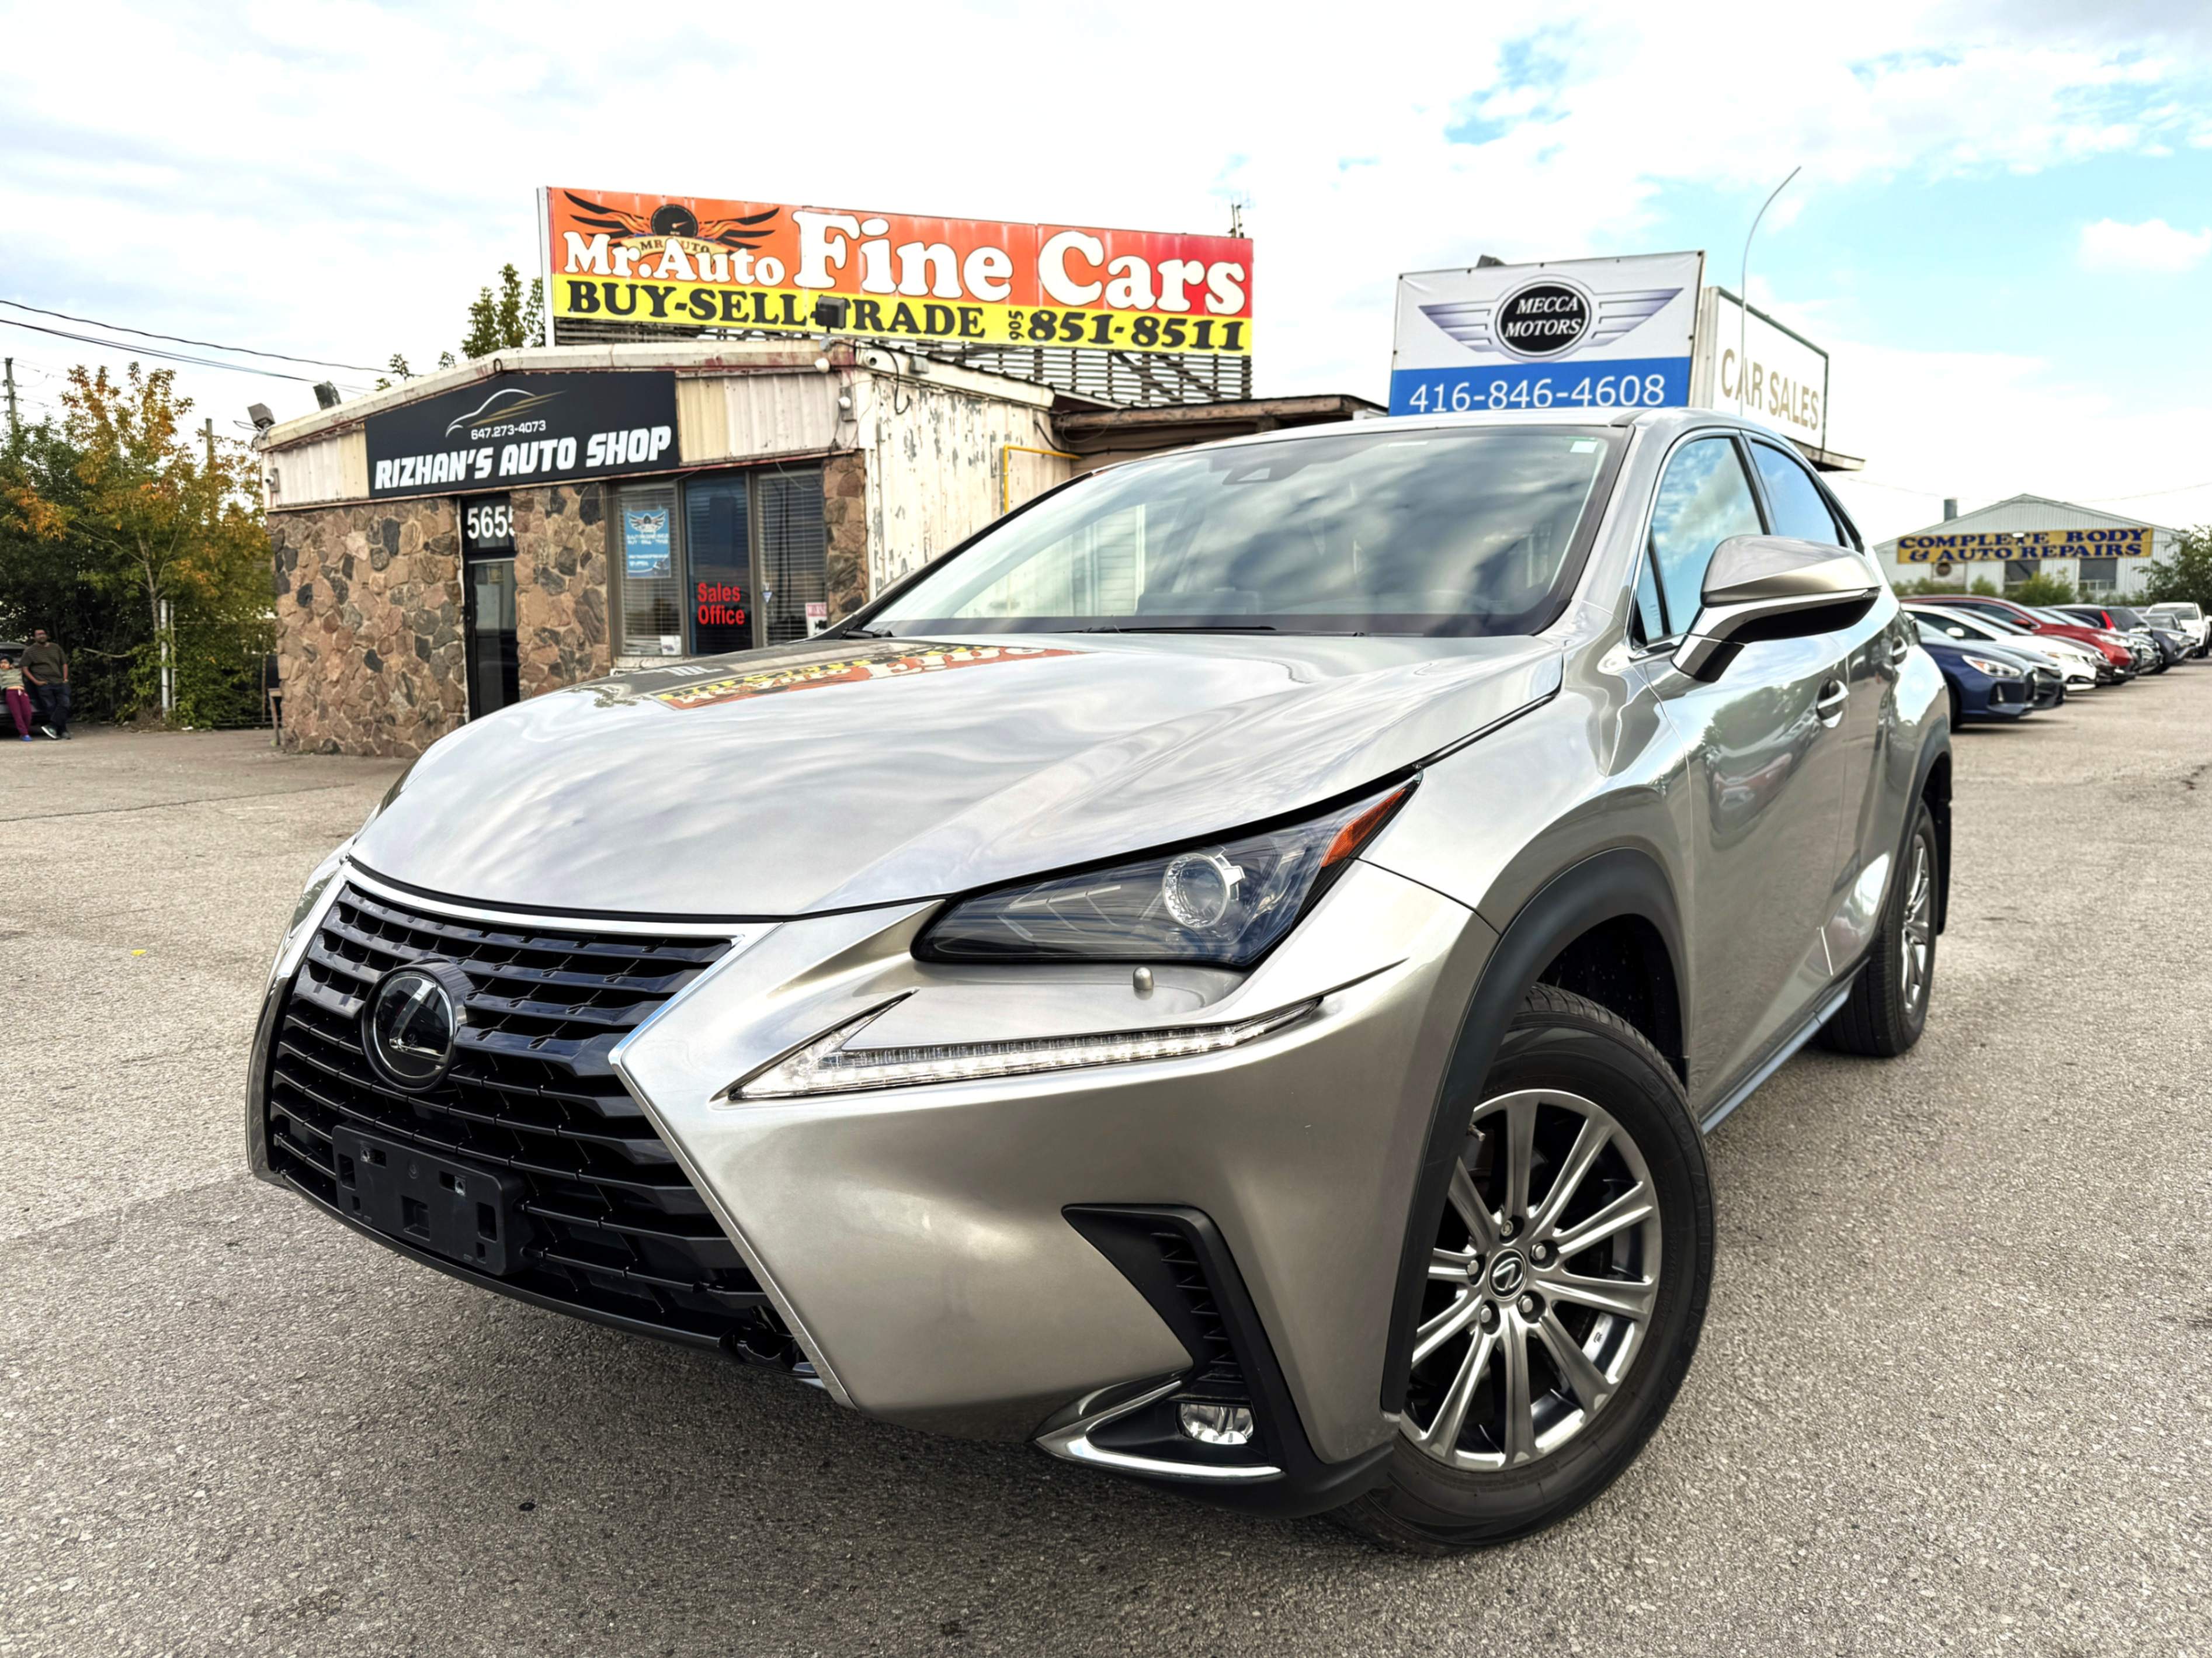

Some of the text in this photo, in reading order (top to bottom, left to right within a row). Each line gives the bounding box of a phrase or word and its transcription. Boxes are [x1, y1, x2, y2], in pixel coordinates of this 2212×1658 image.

[792, 210, 1014, 303] Fine
[1038, 230, 1246, 315] Cars
[1516, 296, 1578, 314] MECCA
[1027, 310, 1245, 351] 851-8511
[1504, 318, 1582, 338] MOTORS
[1409, 374, 1665, 413] 416-846-4608
[1721, 348, 1819, 431] CAR SALES
[471, 420, 547, 440] 647.273-4073
[374, 426, 672, 490] RIZHAN'S AUTO SHOP
[2066, 528, 2150, 543] BODY
[1909, 543, 2142, 562] & AUTO REPAIRS
[697, 582, 741, 603] Sales
[697, 605, 745, 626] Office
